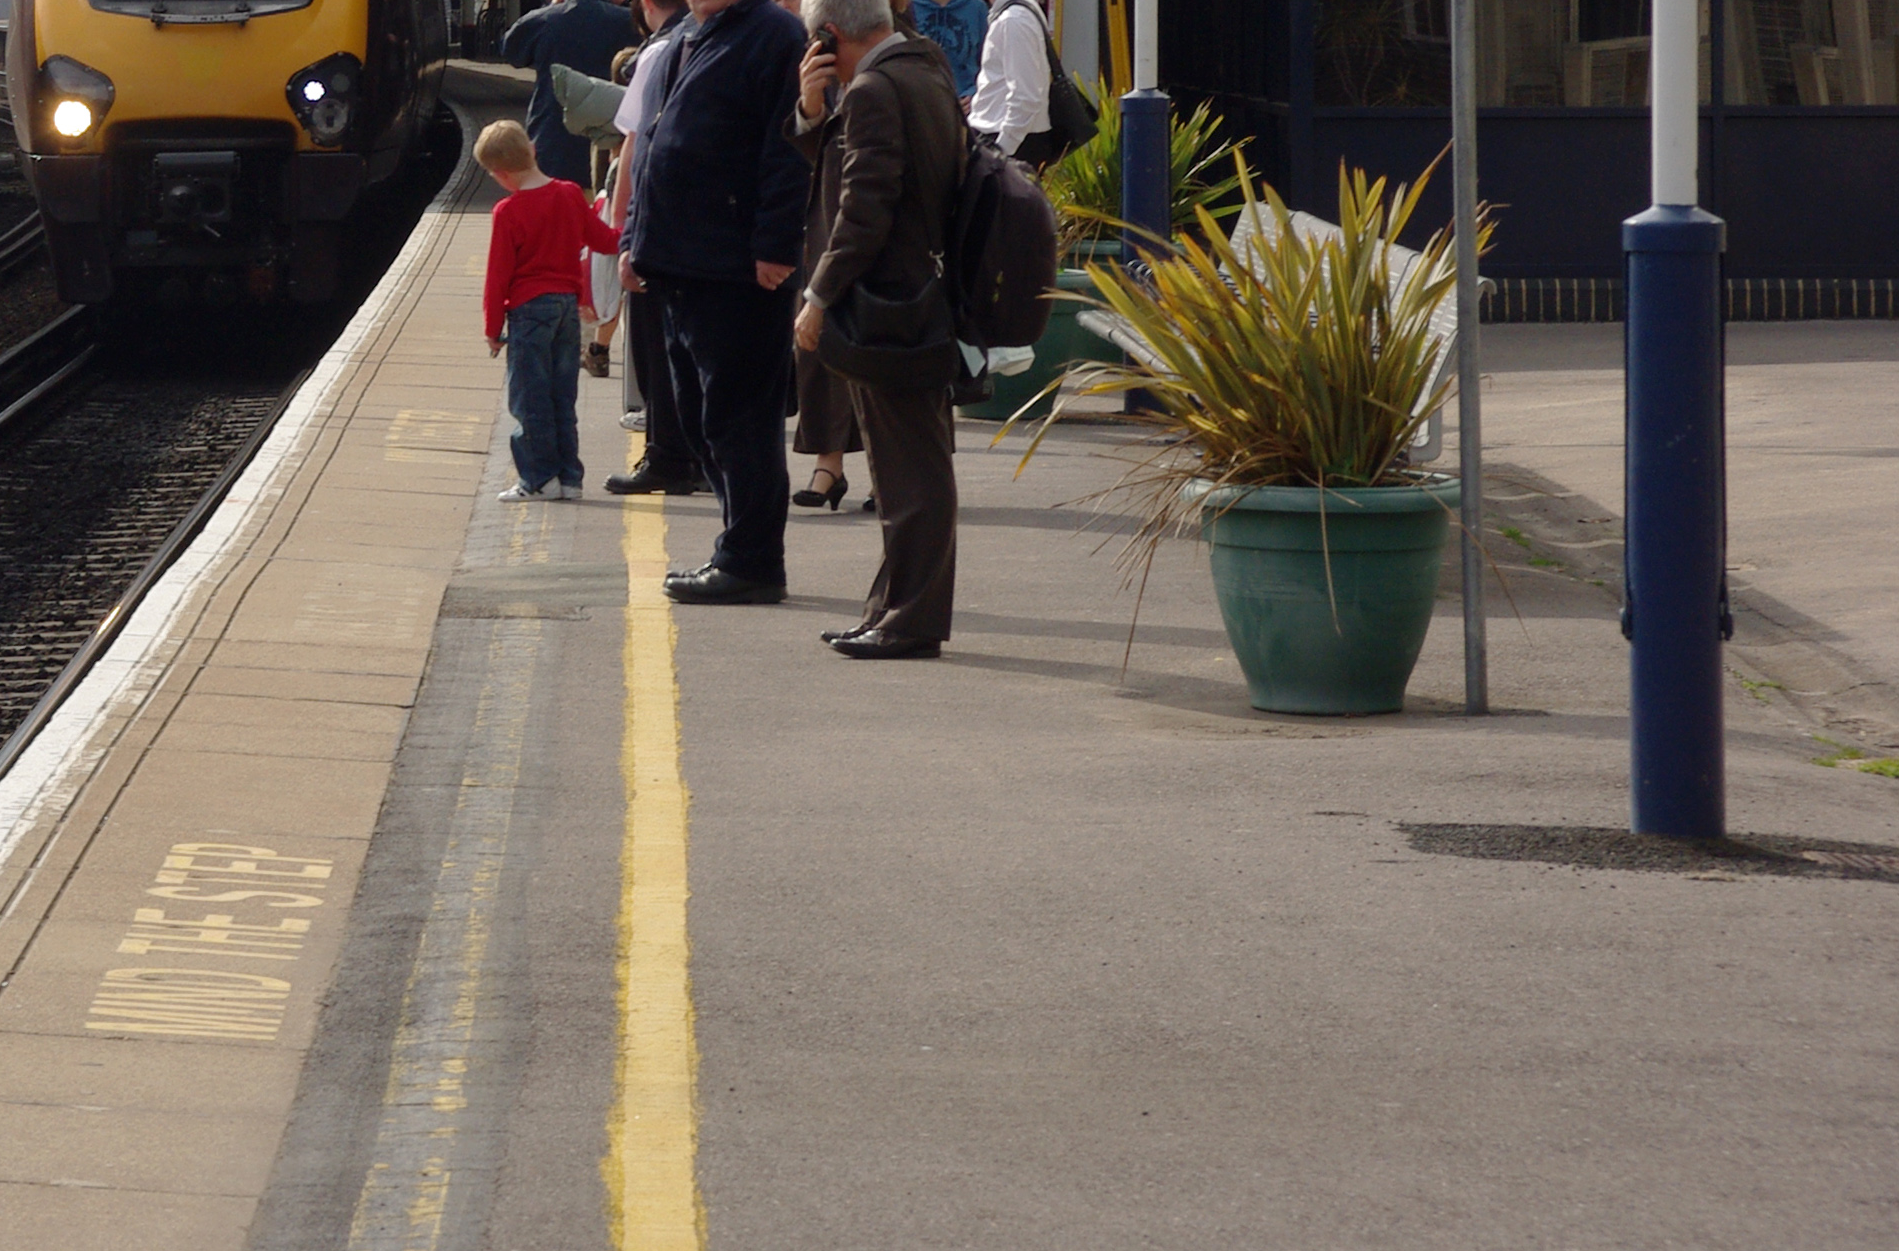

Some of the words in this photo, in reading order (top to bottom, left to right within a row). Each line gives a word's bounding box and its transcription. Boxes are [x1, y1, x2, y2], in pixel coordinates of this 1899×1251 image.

[145, 842, 334, 909] STEP
[116, 907, 312, 961] THE
[84, 967, 292, 1041] MIND
